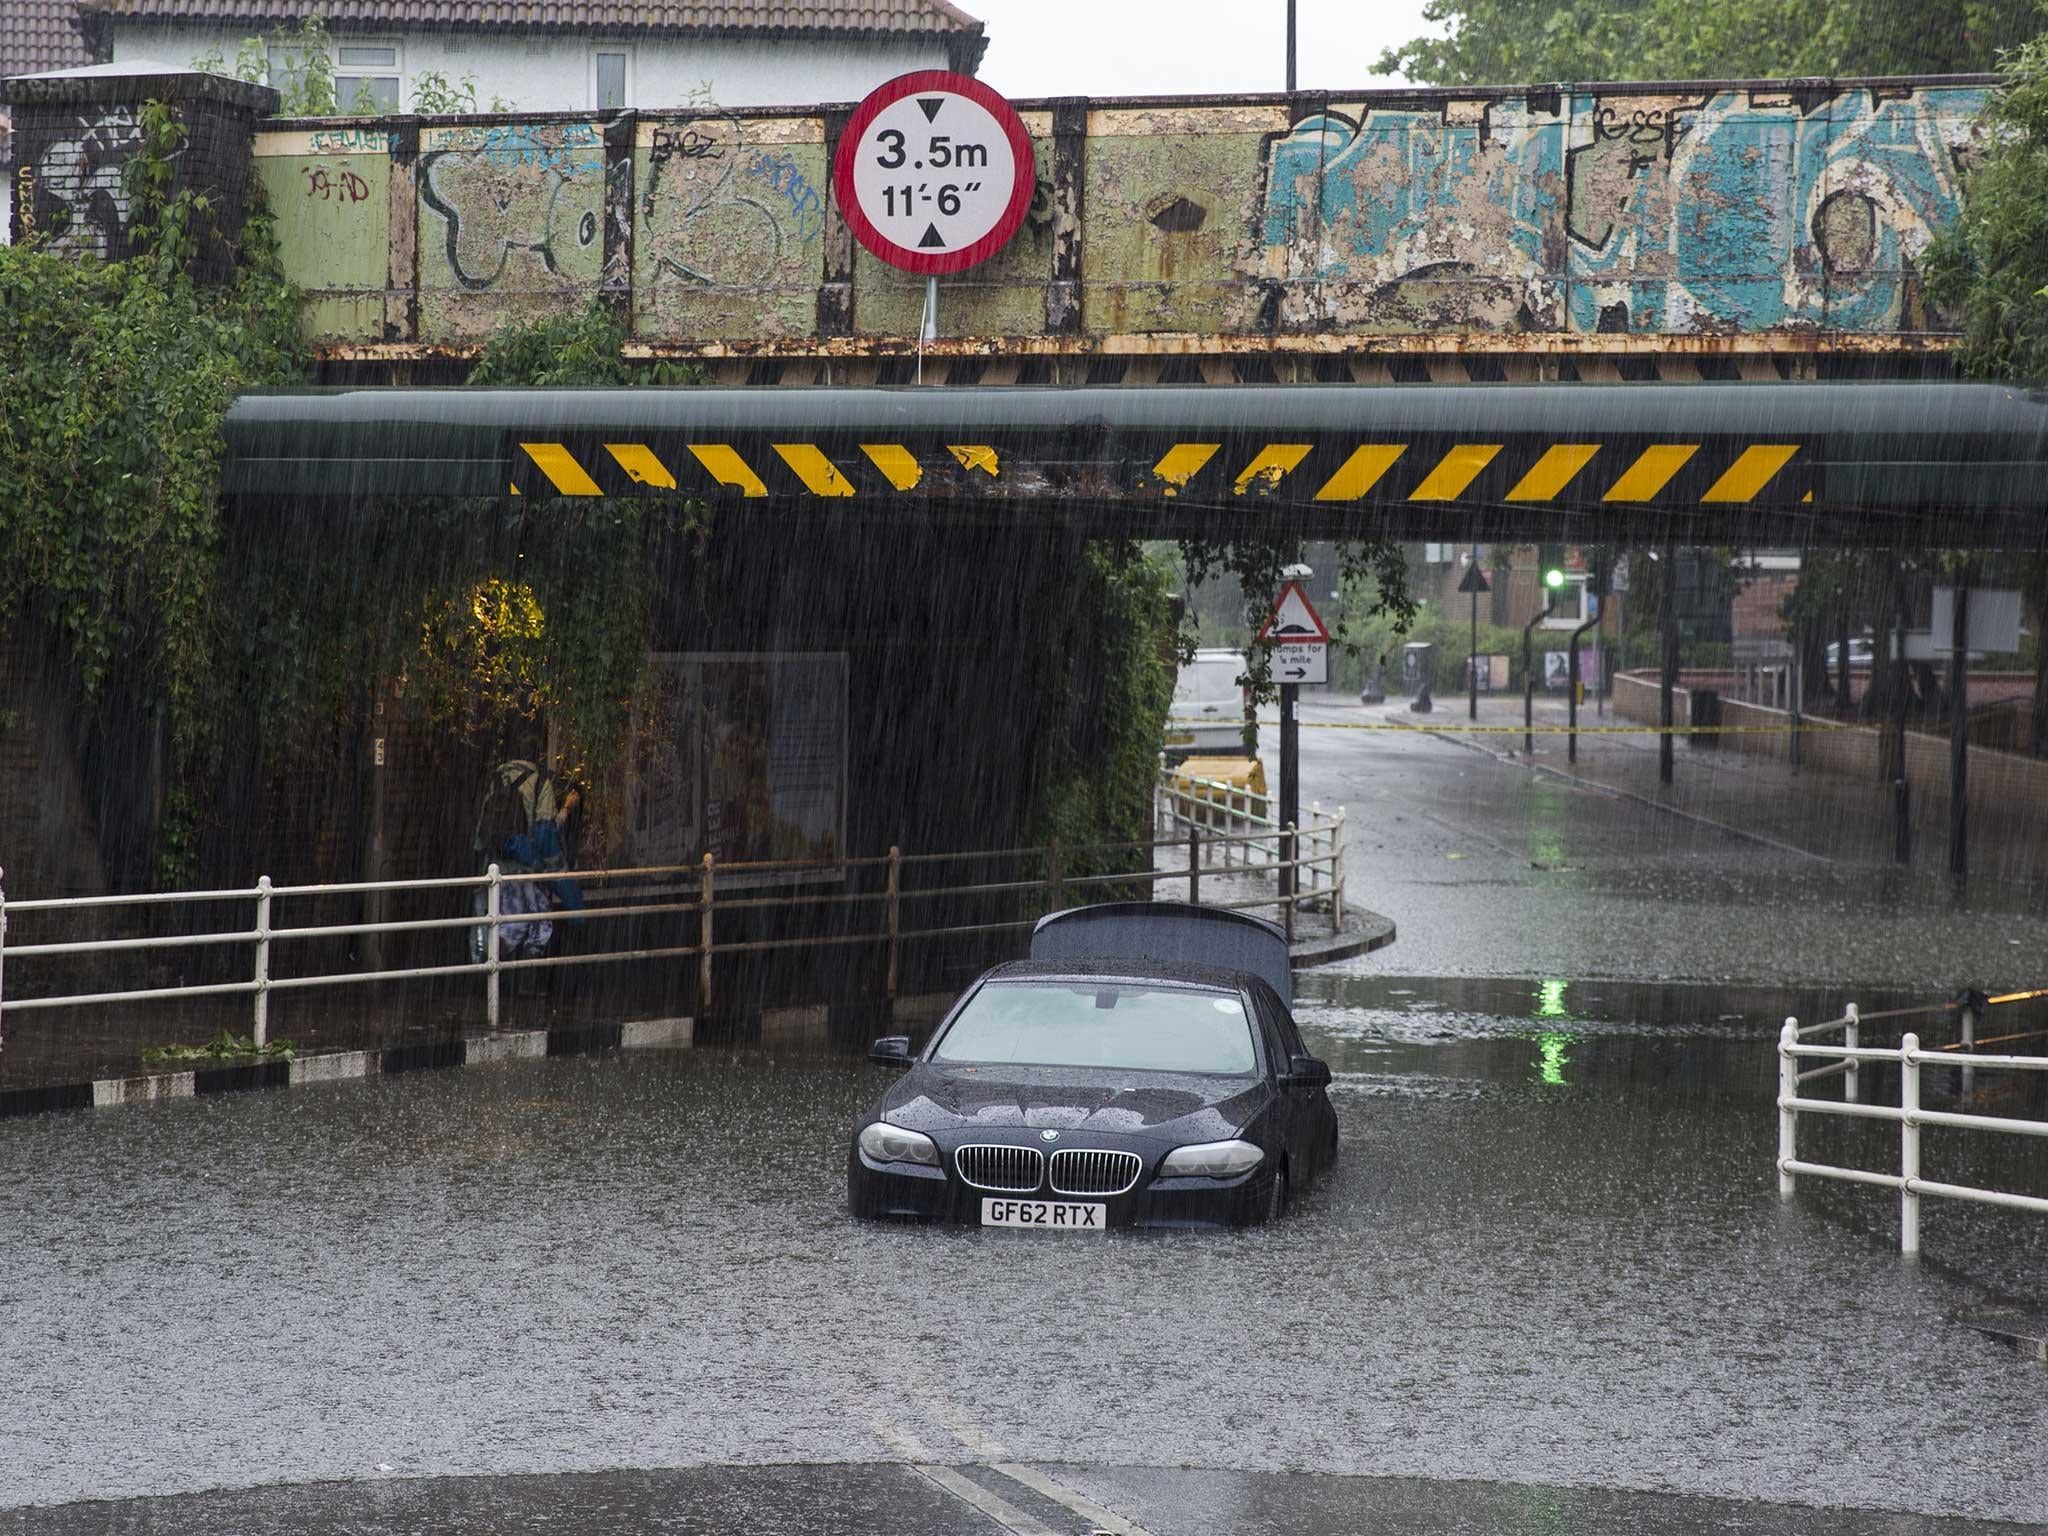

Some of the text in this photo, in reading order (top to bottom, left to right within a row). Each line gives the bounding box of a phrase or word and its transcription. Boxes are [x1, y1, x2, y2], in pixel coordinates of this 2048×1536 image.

[876, 129, 987, 169] 3.5m
[1308, 644, 1322, 653] for
[1290, 655, 1312, 664] mile
[991, 1201, 1096, 1226] GF62 RTX
